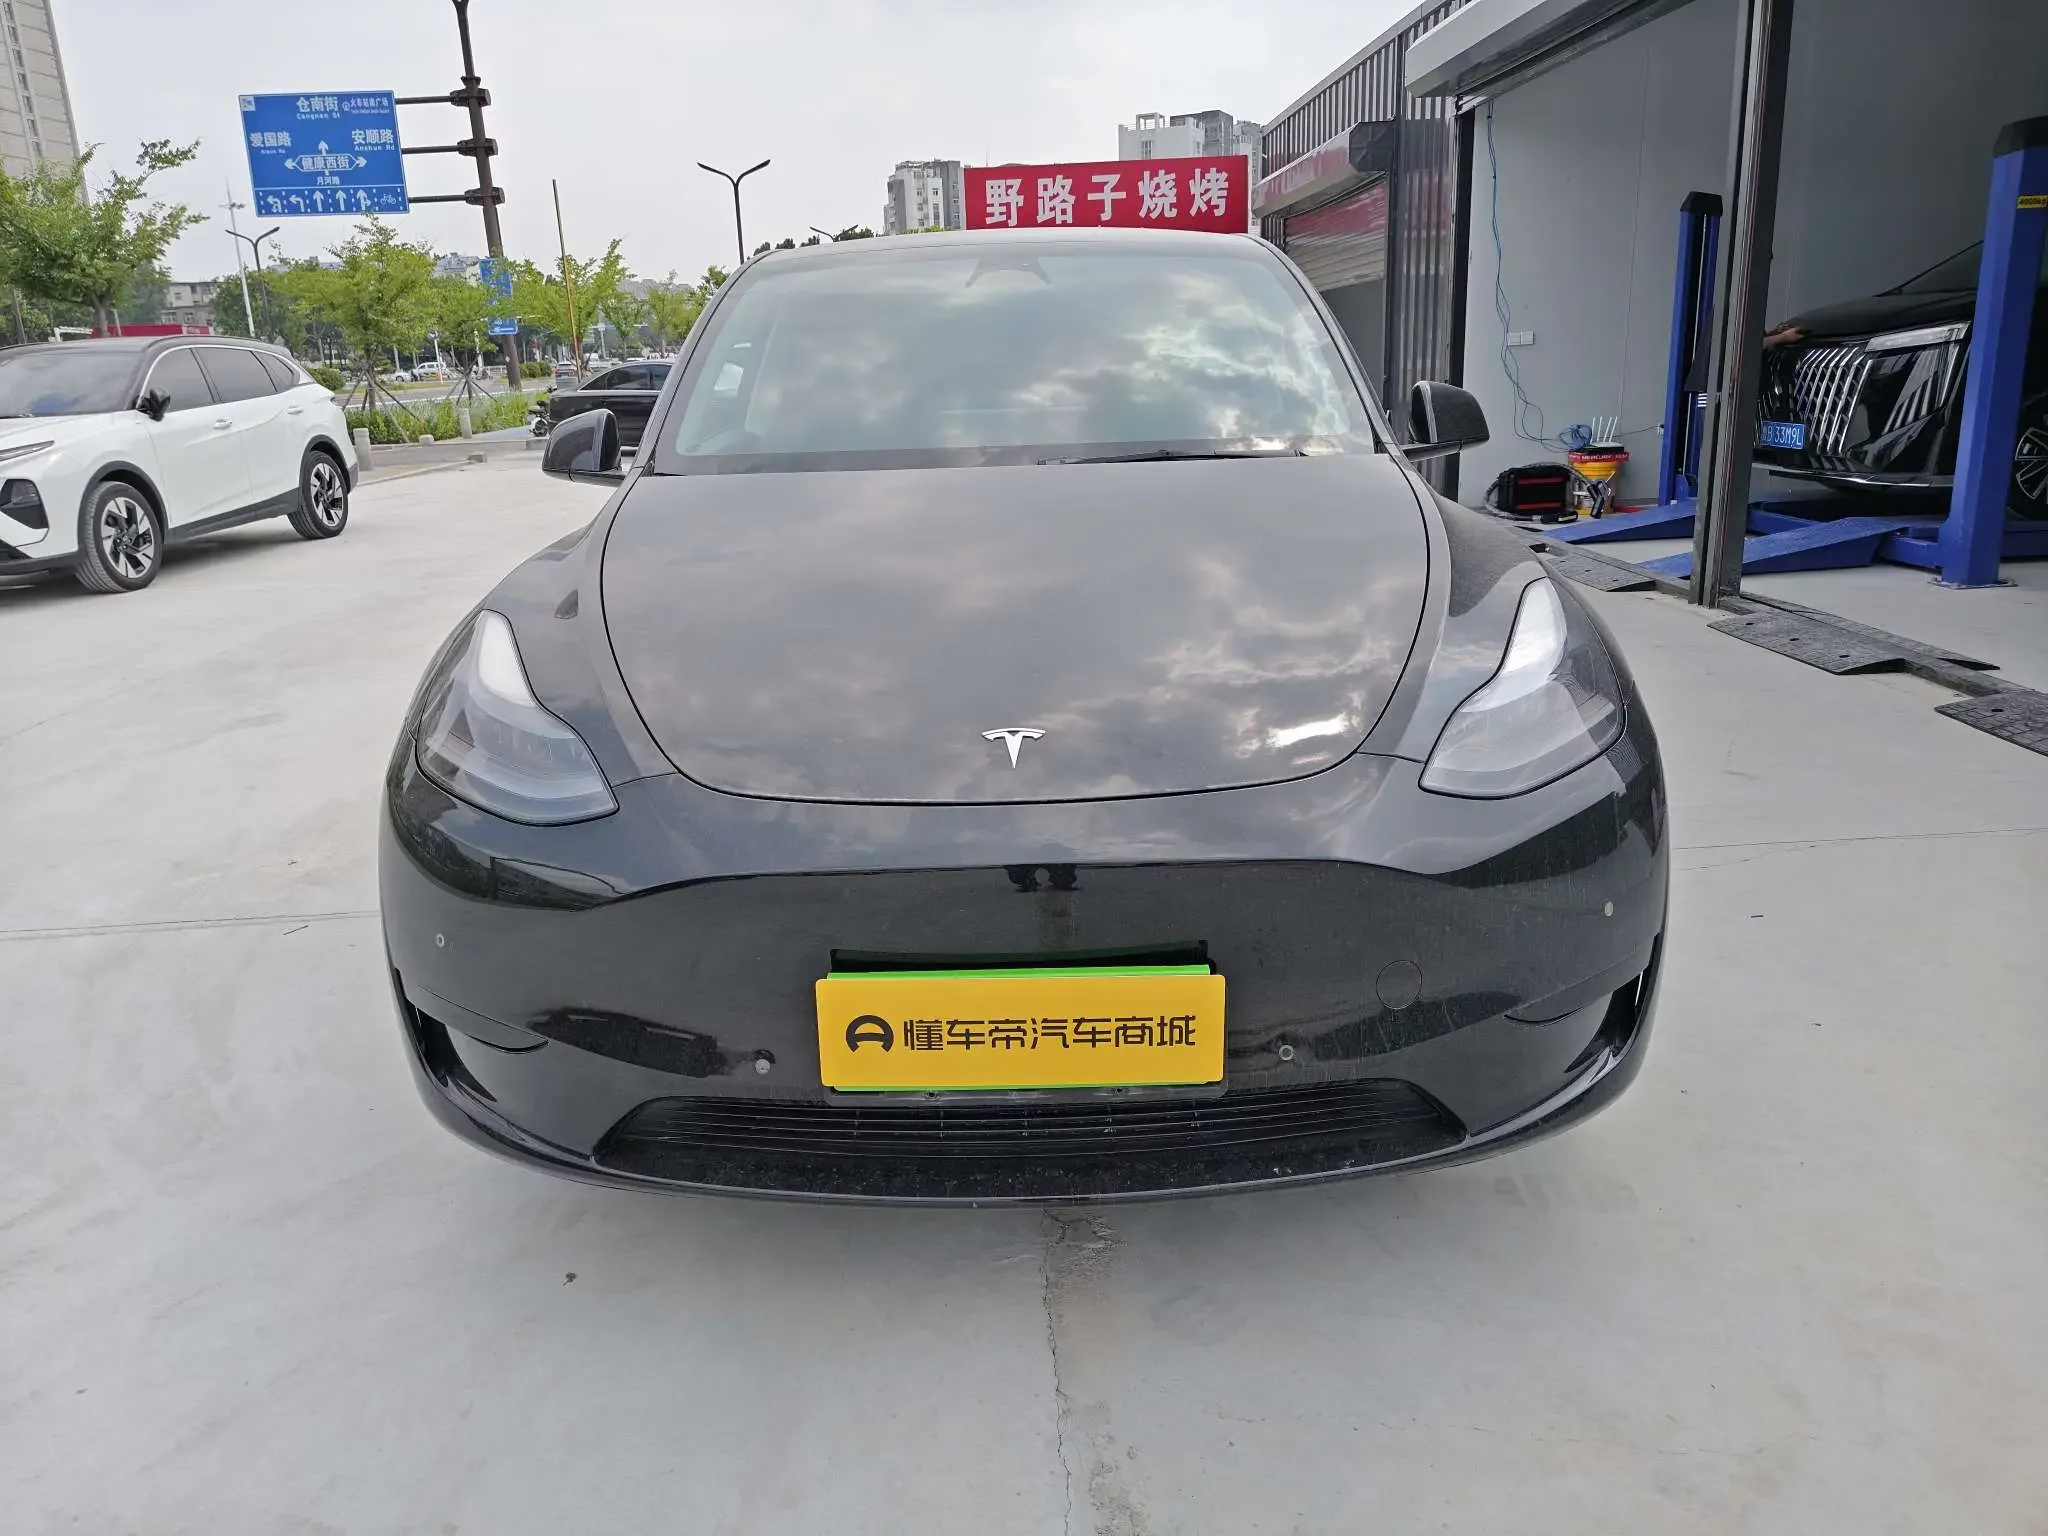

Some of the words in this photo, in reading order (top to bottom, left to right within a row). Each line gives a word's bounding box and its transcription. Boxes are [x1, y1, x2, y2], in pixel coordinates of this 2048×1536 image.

[296, 96, 339, 113] 仓南街
[296, 112, 329, 121] Cangnan
[249, 132, 292, 147] 爱国路
[351, 128, 394, 144] 安顺路
[301, 156, 350, 170] 健康西街
[985, 167, 1229, 227] 野路子烧烤
[903, 1015, 1196, 1051] 懂车帝汽车商城
